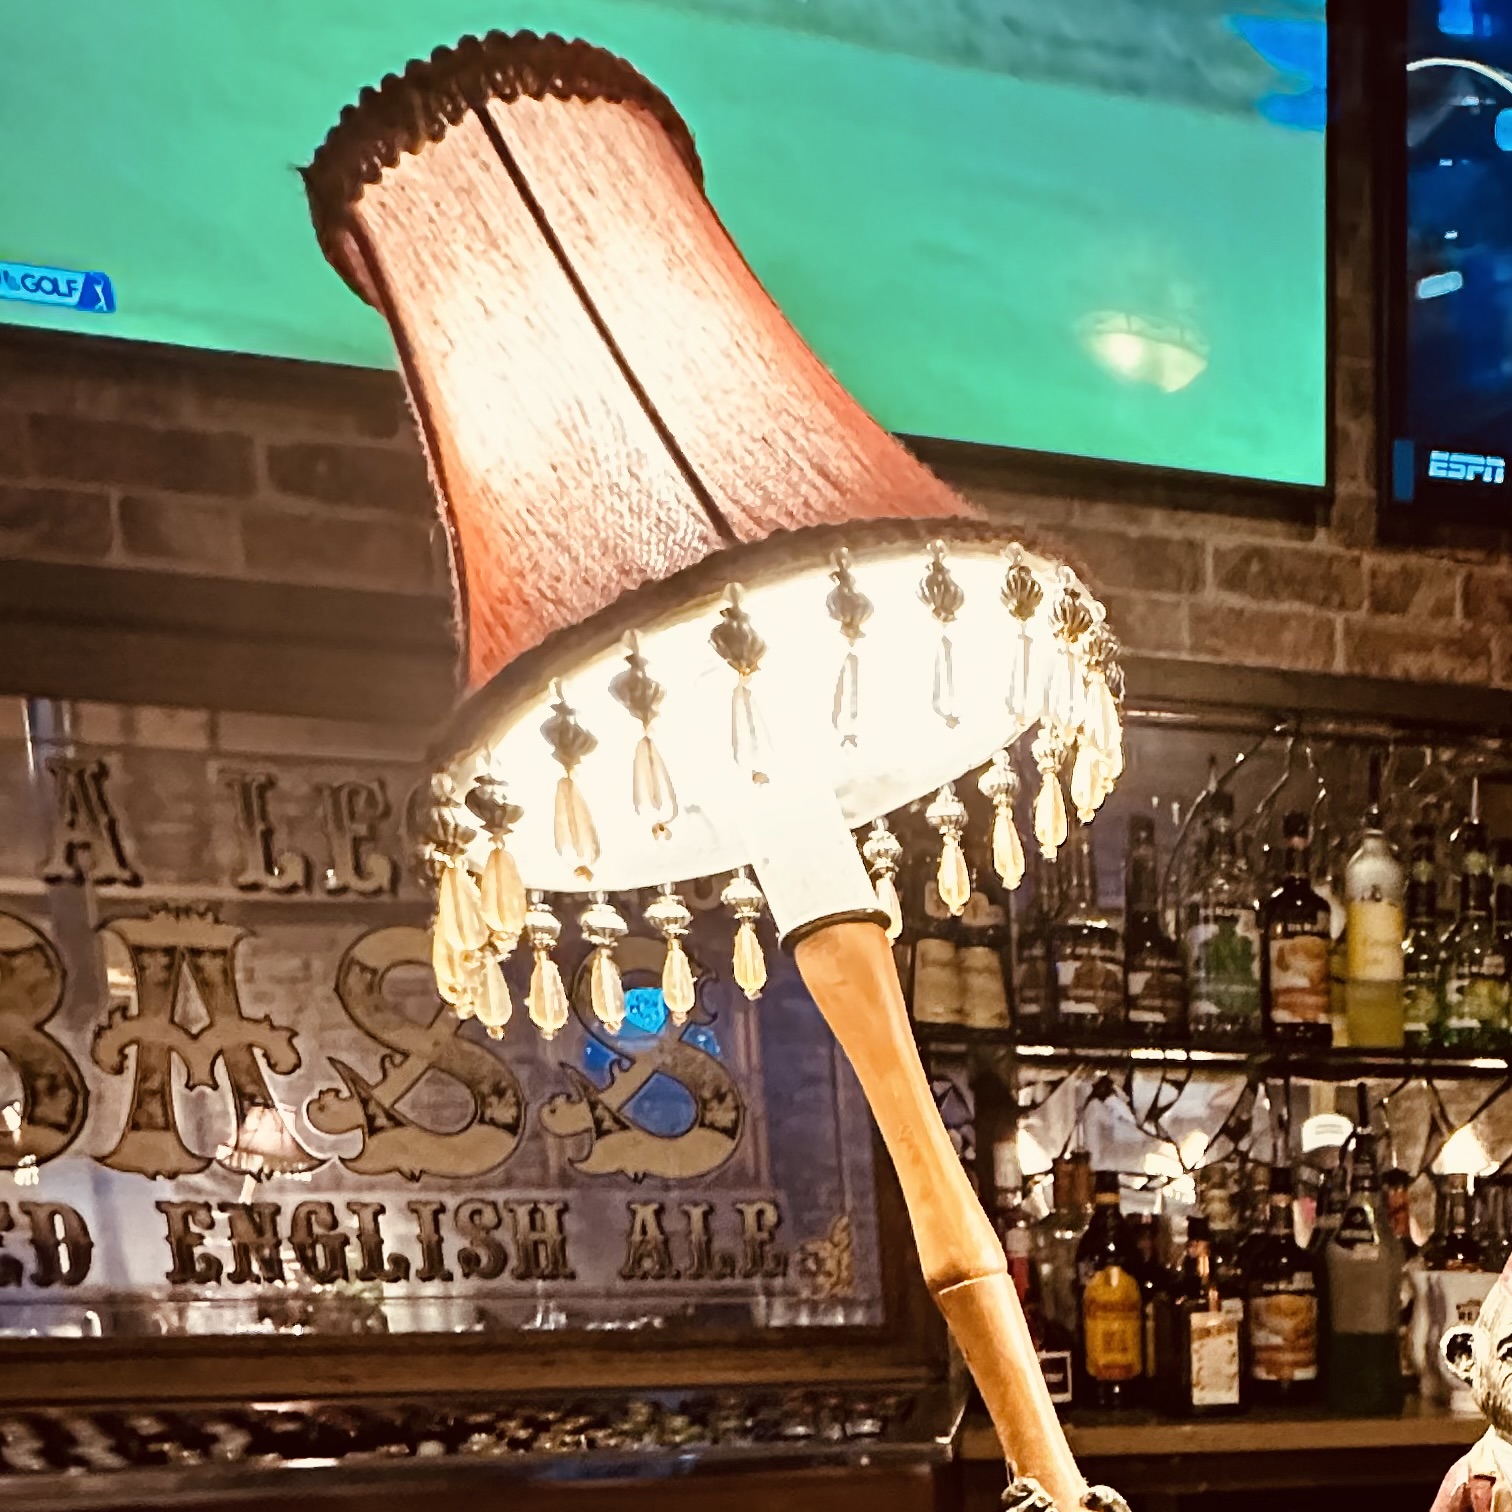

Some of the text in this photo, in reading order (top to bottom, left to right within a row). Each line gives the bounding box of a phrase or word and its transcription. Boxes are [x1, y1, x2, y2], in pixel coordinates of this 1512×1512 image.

[20, 273, 79, 297] GOLF
[1428, 450, 1506, 484] ESPN
[44, 760, 144, 888] A
[155, 1199, 577, 1287] ENGLISH
[618, 1199, 790, 1281] ALE
